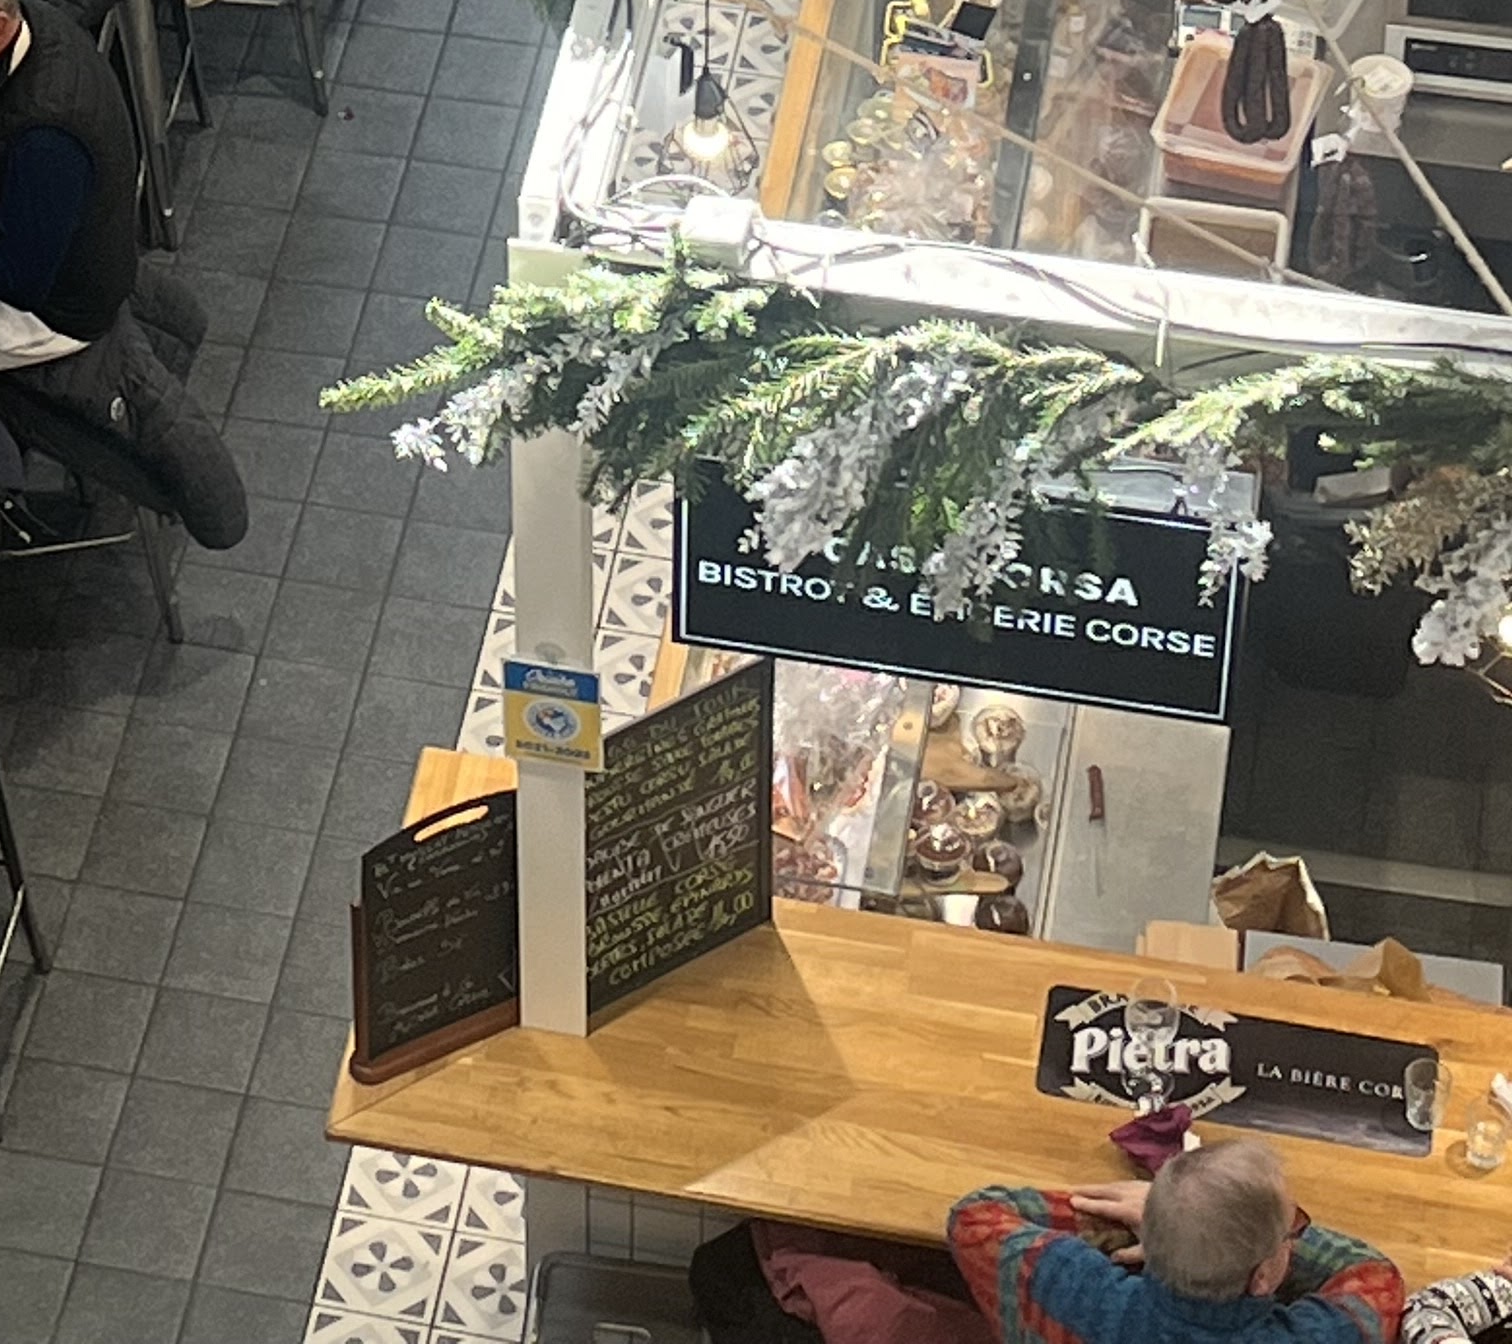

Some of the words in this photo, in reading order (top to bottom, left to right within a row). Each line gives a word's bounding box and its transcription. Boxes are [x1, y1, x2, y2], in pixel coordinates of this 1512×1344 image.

[697, 559, 854, 605] BISTRO
[861, 586, 901, 612] &
[1084, 618, 1217, 659] CORSE
[1072, 1026, 1231, 1074] Pietra
[1256, 1062, 1283, 1080] LA
[1289, 1067, 1352, 1092] BIÈRE
